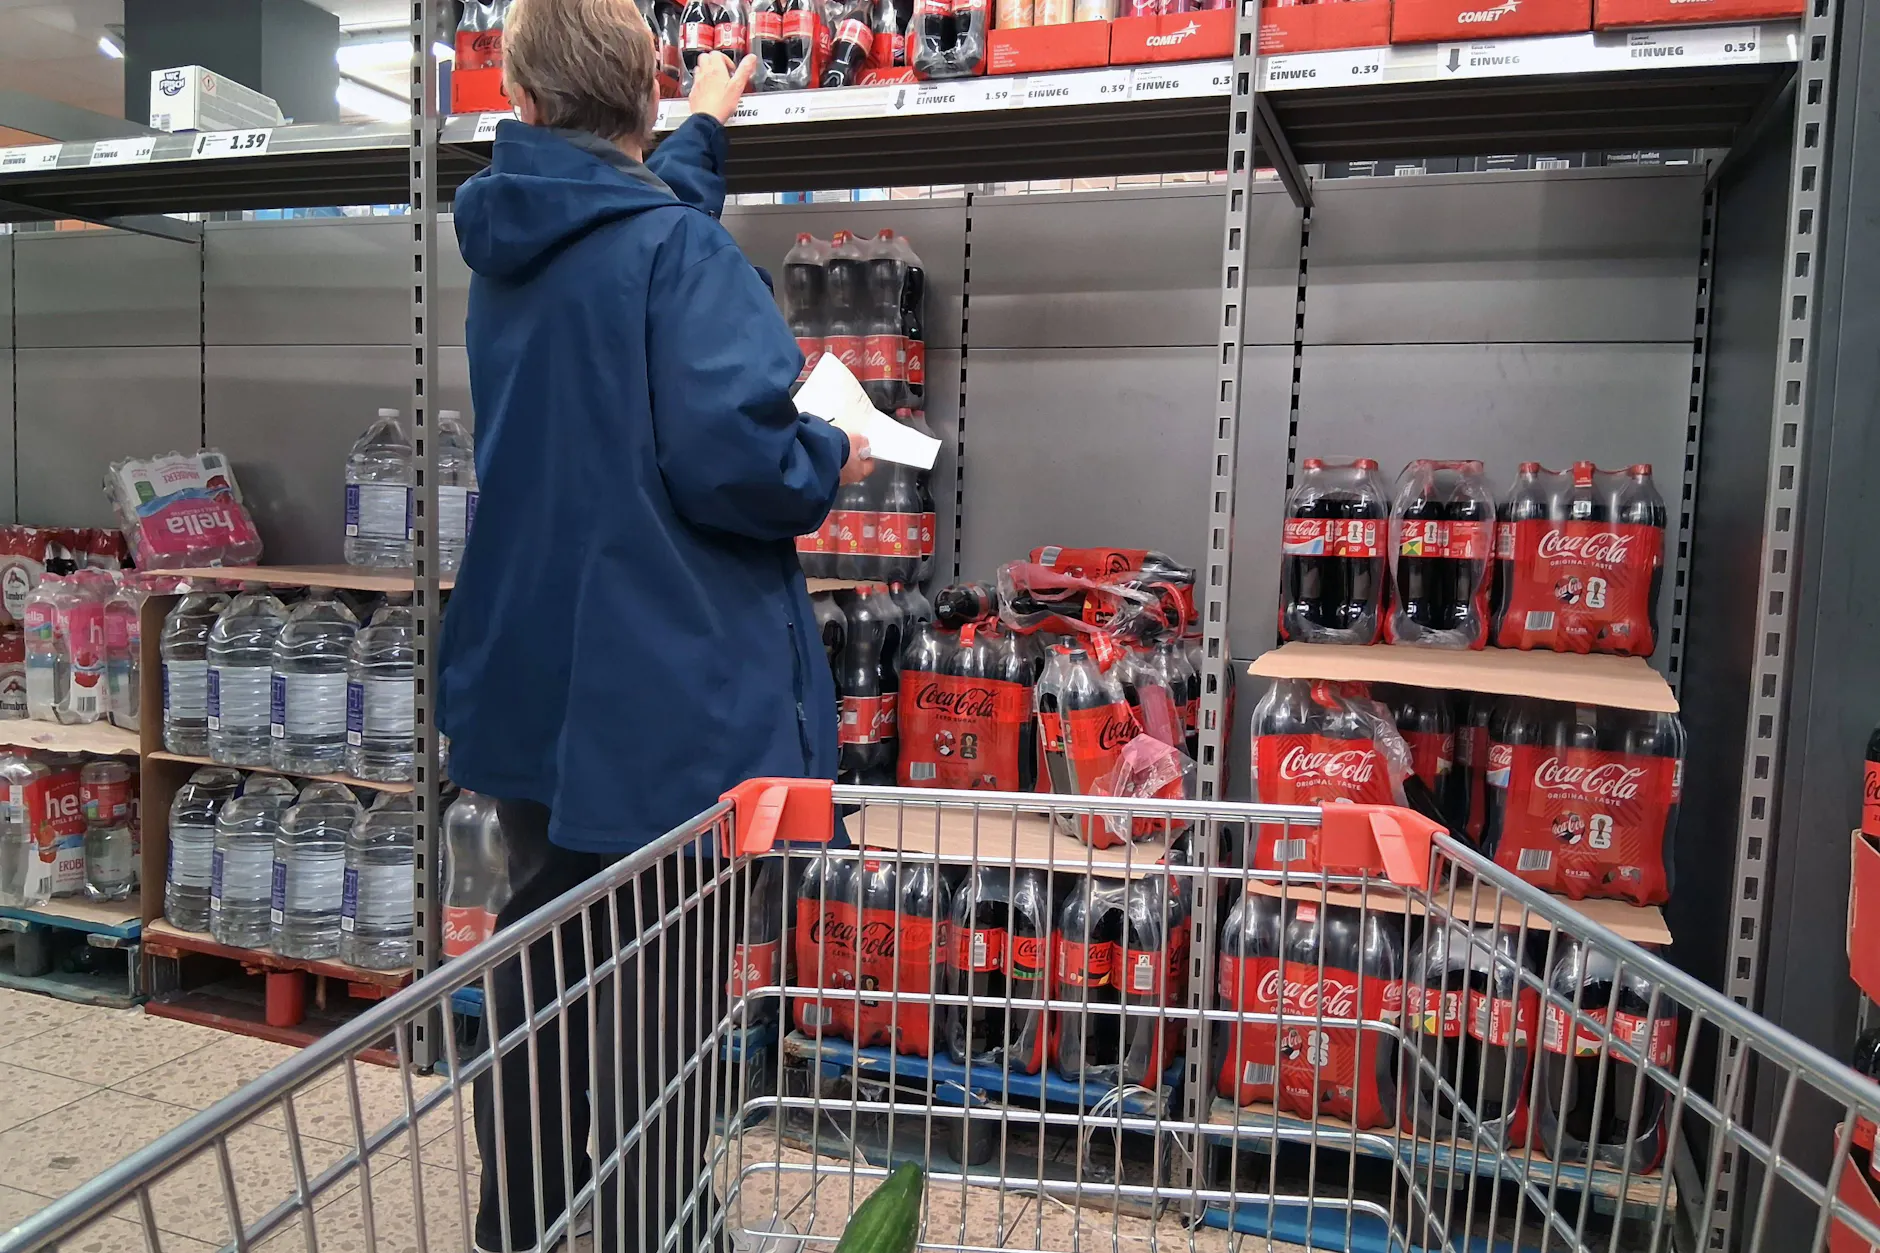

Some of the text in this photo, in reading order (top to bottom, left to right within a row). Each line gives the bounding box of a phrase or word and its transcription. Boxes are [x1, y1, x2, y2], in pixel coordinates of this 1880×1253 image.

[1457, 10, 1504, 24] COMET
[471, 33, 503, 53] Coca-C
[1146, 34, 1185, 47] COMET
[1631, 42, 1756, 58] EINWEG 0.39
[1470, 55, 1521, 67] EINWEG
[165, 72, 180, 81] WC
[860, 70, 917, 86] Coca-C
[1270, 64, 1379, 81] EINWEG 0.39
[1136, 75, 1233, 91] EINWEG 0.3
[916, 91, 1008, 106] EINWEG 1.59
[1028, 84, 1125, 99] EINWEG 0.39
[730, 106, 806, 119] NWEG 0.75
[478, 125, 497, 133] EIN
[229, 133, 266, 150] 1.39
[2, 154, 57, 166] EINWEG 1.29
[93, 148, 151, 159] EINWEG 1.59
[166, 510, 235, 536] hella
[1538, 529, 1635, 564] Coca-Cola
[1550, 559, 1613, 571] ORIGINAL TASTE
[25, 611, 44, 622] ella
[126, 621, 140, 632] hel
[916, 683, 998, 718] Coca-Cola
[1281, 746, 1376, 782] Coca-Cola
[1296, 779, 1361, 791] ORIGINAL TASTE
[1534, 757, 1648, 800] Coca-Cola
[1548, 793, 1621, 807] ORIGINAL TASTE
[59, 858, 84, 872] ERDB
[1491, 1014, 1499, 1043] RECYCLE
[1557, 1024, 1565, 1052] RECYCLE
